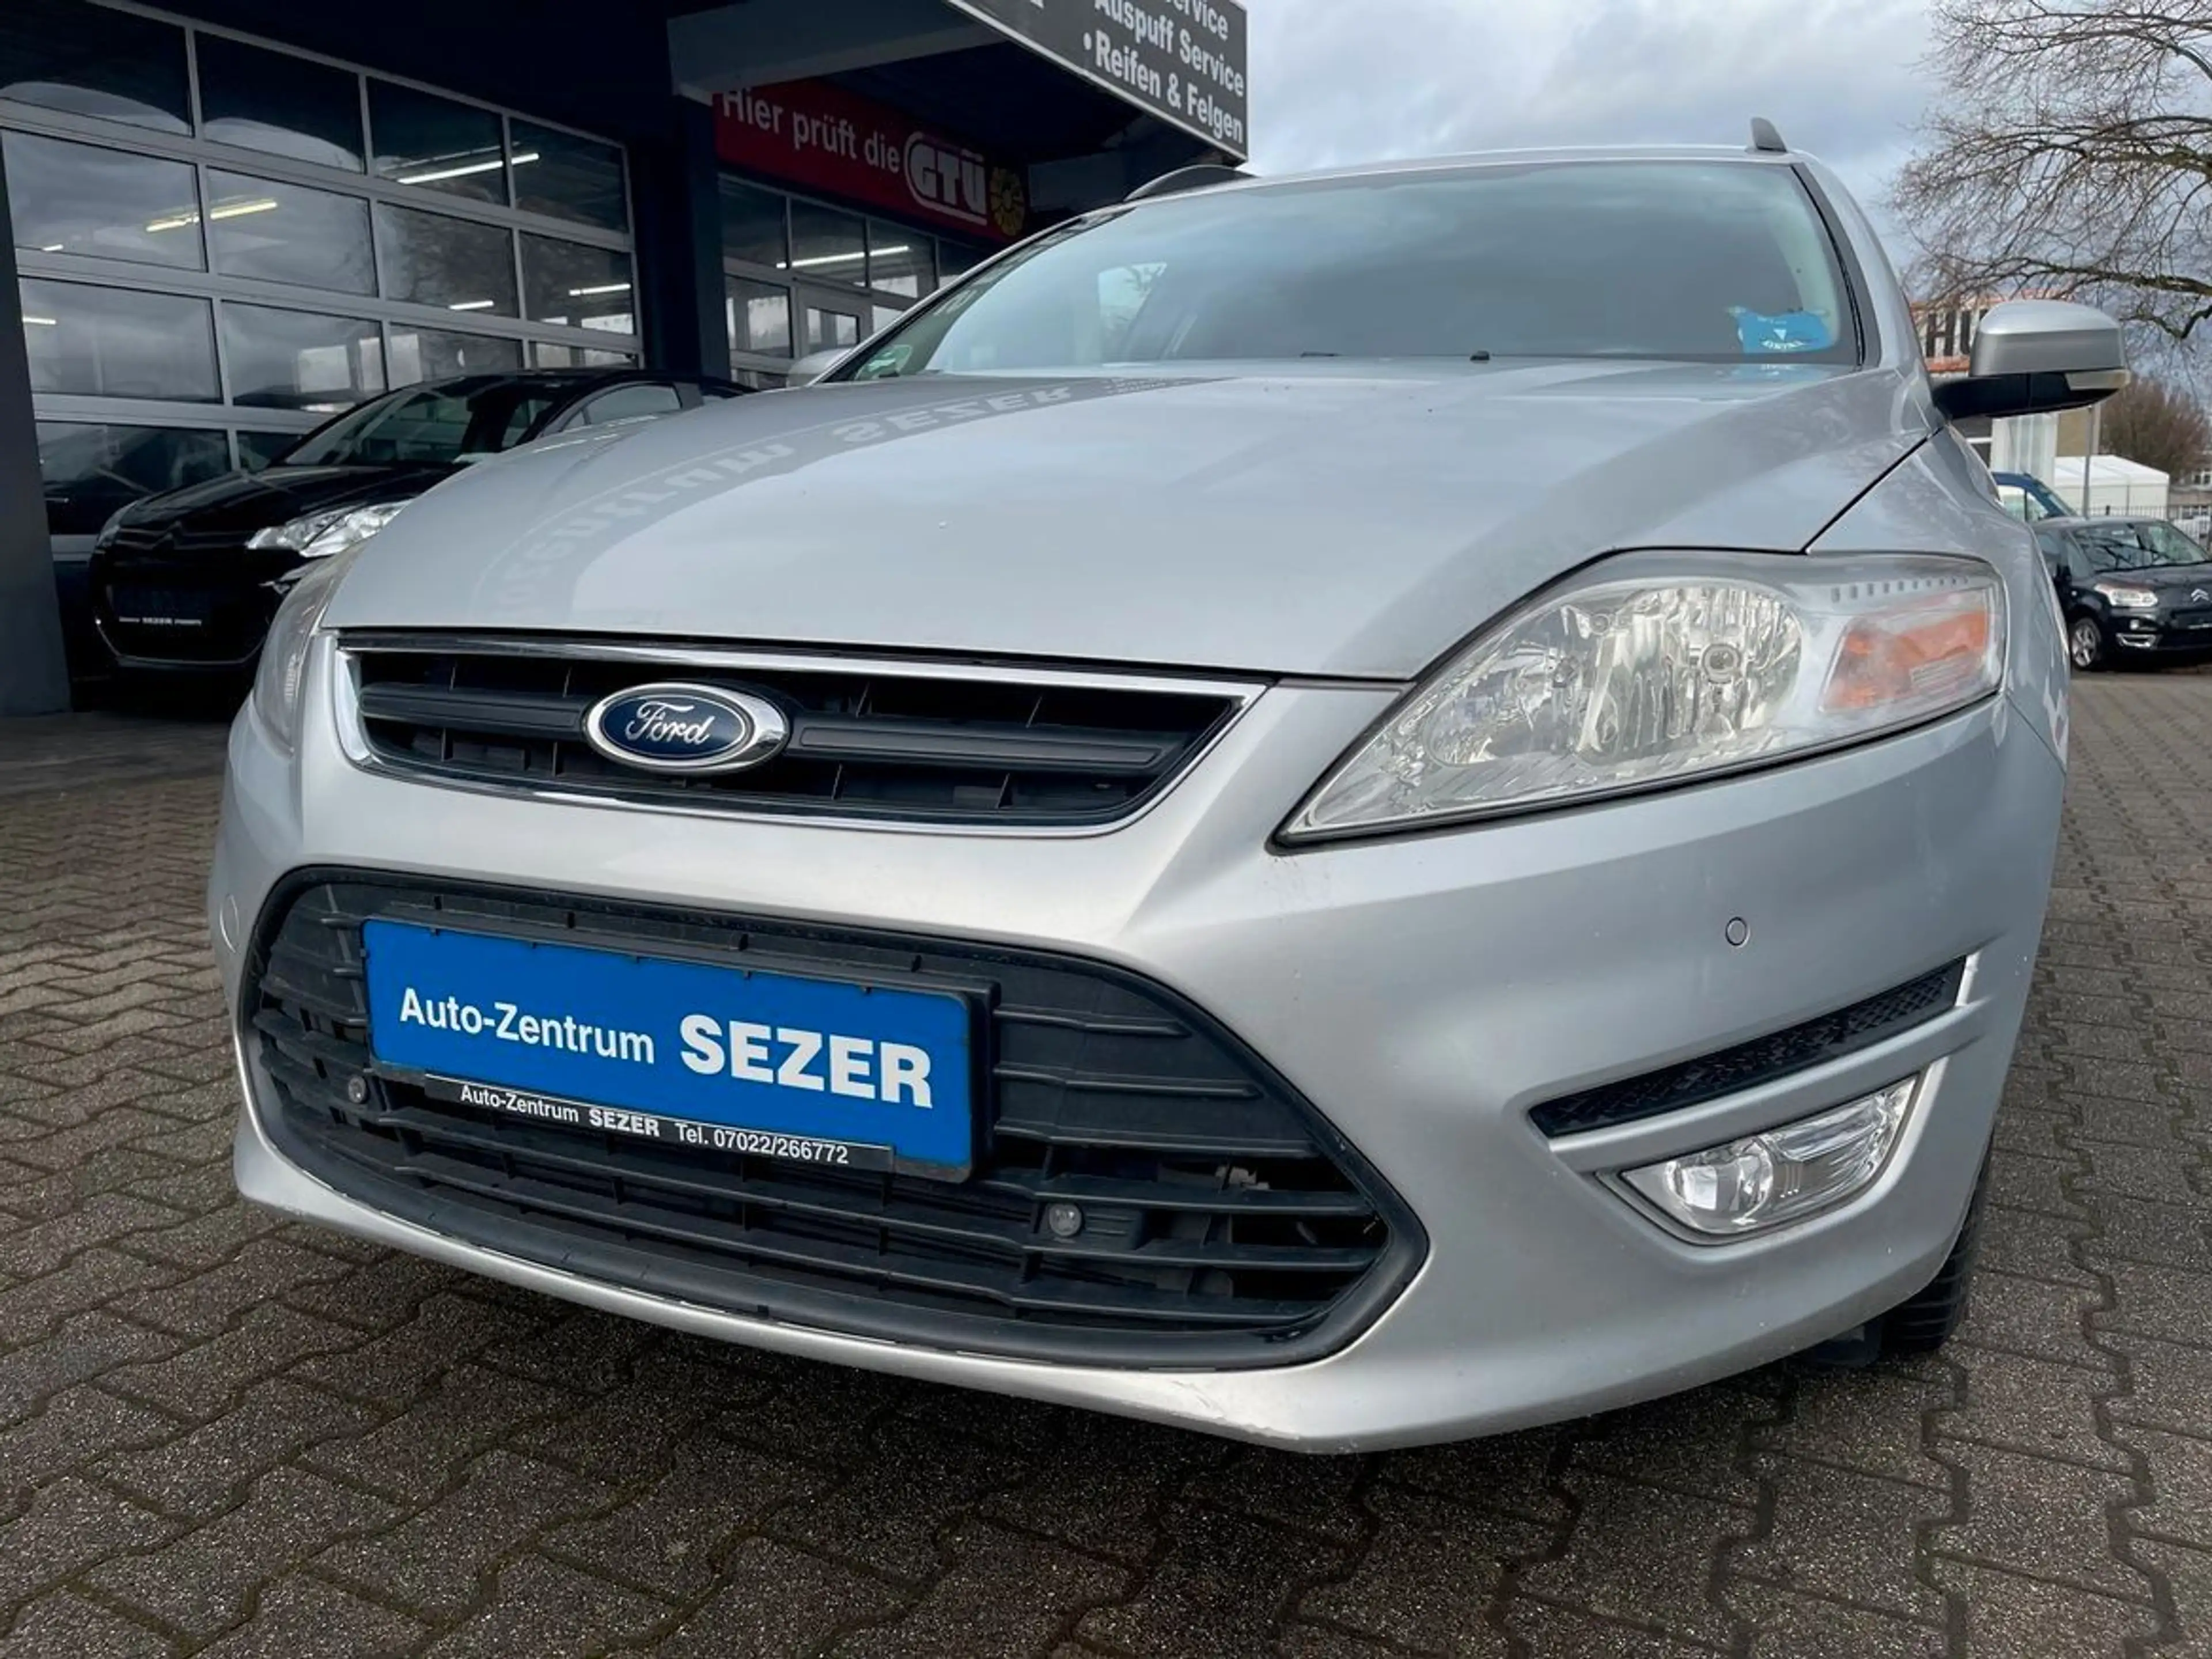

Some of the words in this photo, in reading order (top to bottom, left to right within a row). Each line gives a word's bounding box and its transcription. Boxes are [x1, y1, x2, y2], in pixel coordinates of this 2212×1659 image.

[1166, 0, 1229, 41] rvice
[1096, 30, 1161, 99] Reifen
[1167, 73, 1181, 109] &
[1187, 82, 1243, 144] Felgen
[1179, 28, 1244, 97] Service
[723, 87, 784, 134] Hier
[793, 111, 858, 160] prüft
[863, 131, 900, 173] die
[907, 137, 987, 218] GTÜ
[625, 700, 715, 745] Ford
[400, 987, 655, 1065] Auto-Zentrum
[680, 1014, 933, 1109] SEZER
[460, 1085, 579, 1123] Auto-Zentrum
[589, 1109, 660, 1137] SEZER
[675, 1122, 709, 1146] Tel.
[714, 1129, 849, 1165] 07022/266772
